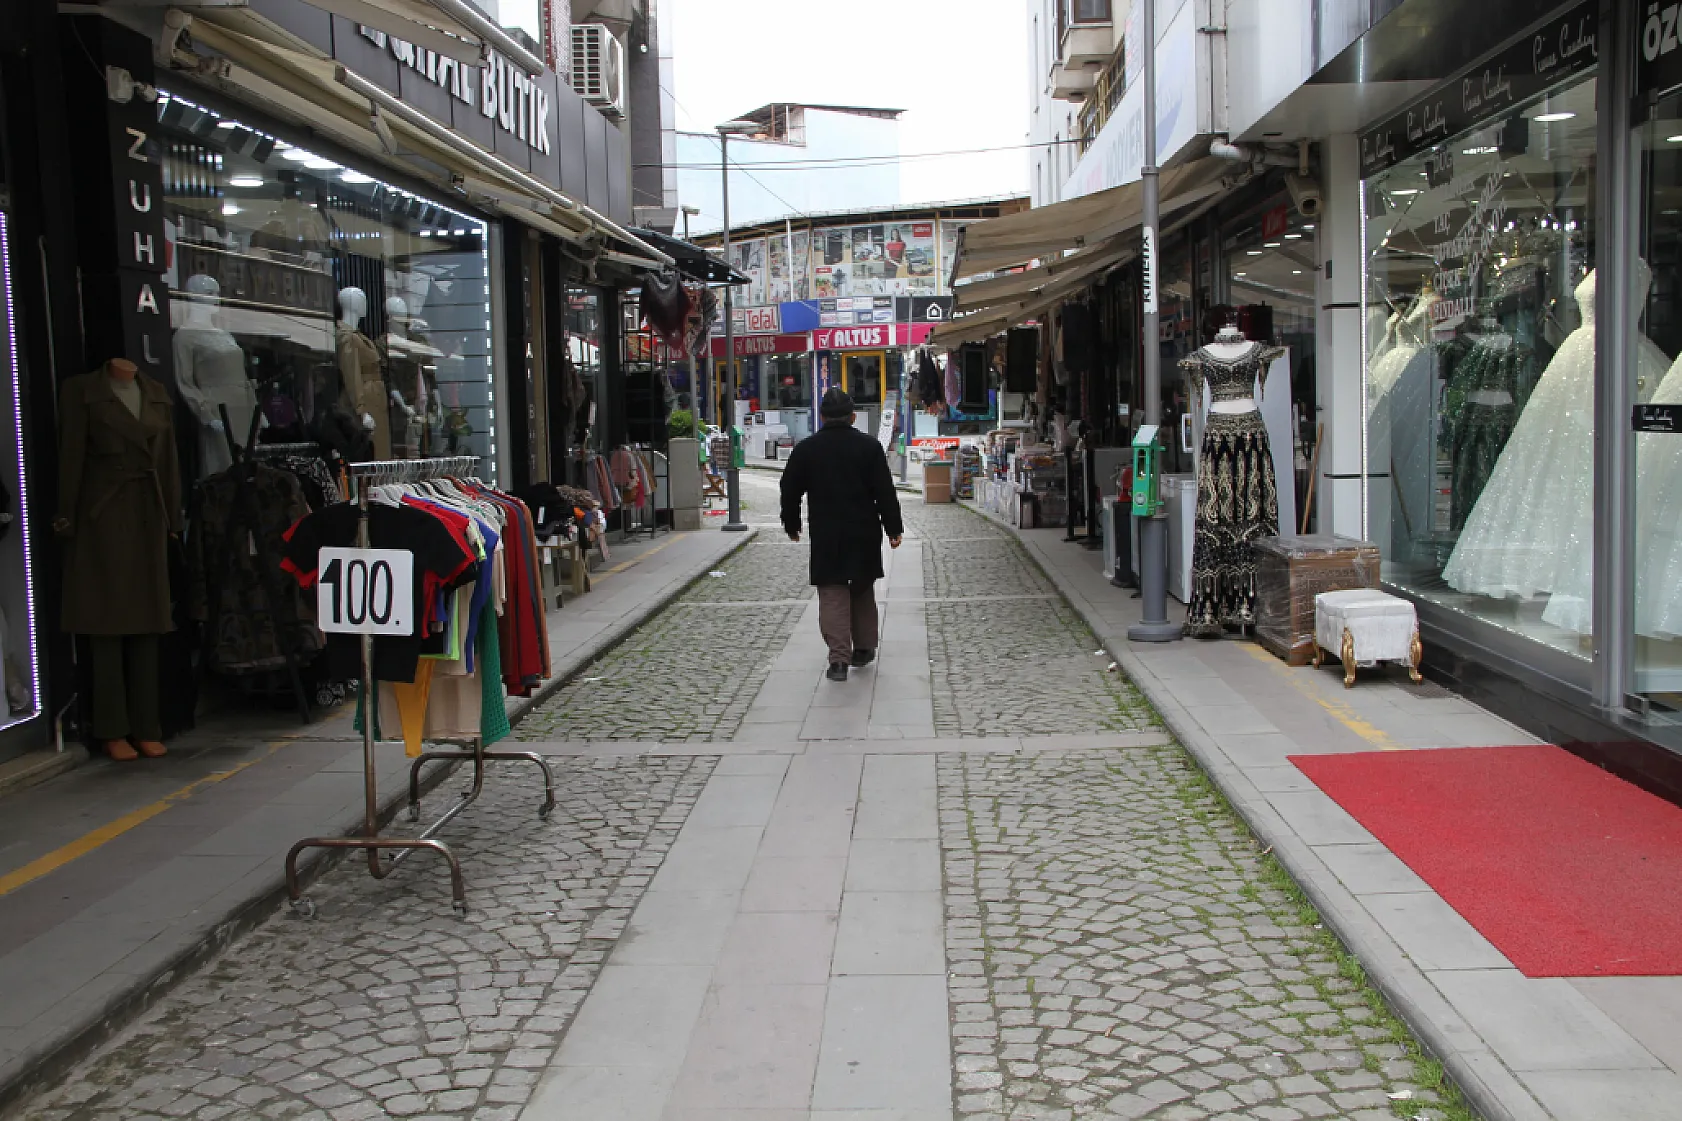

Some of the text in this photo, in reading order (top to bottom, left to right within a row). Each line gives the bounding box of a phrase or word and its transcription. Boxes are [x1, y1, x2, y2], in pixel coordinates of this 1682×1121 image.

[1642, 1, 1682, 62] ÖZ
[125, 126, 161, 364] ZUHAL
[745, 308, 778, 331] Tefal
[744, 336, 776, 354] ALTUS
[834, 327, 882, 347] ALTUS
